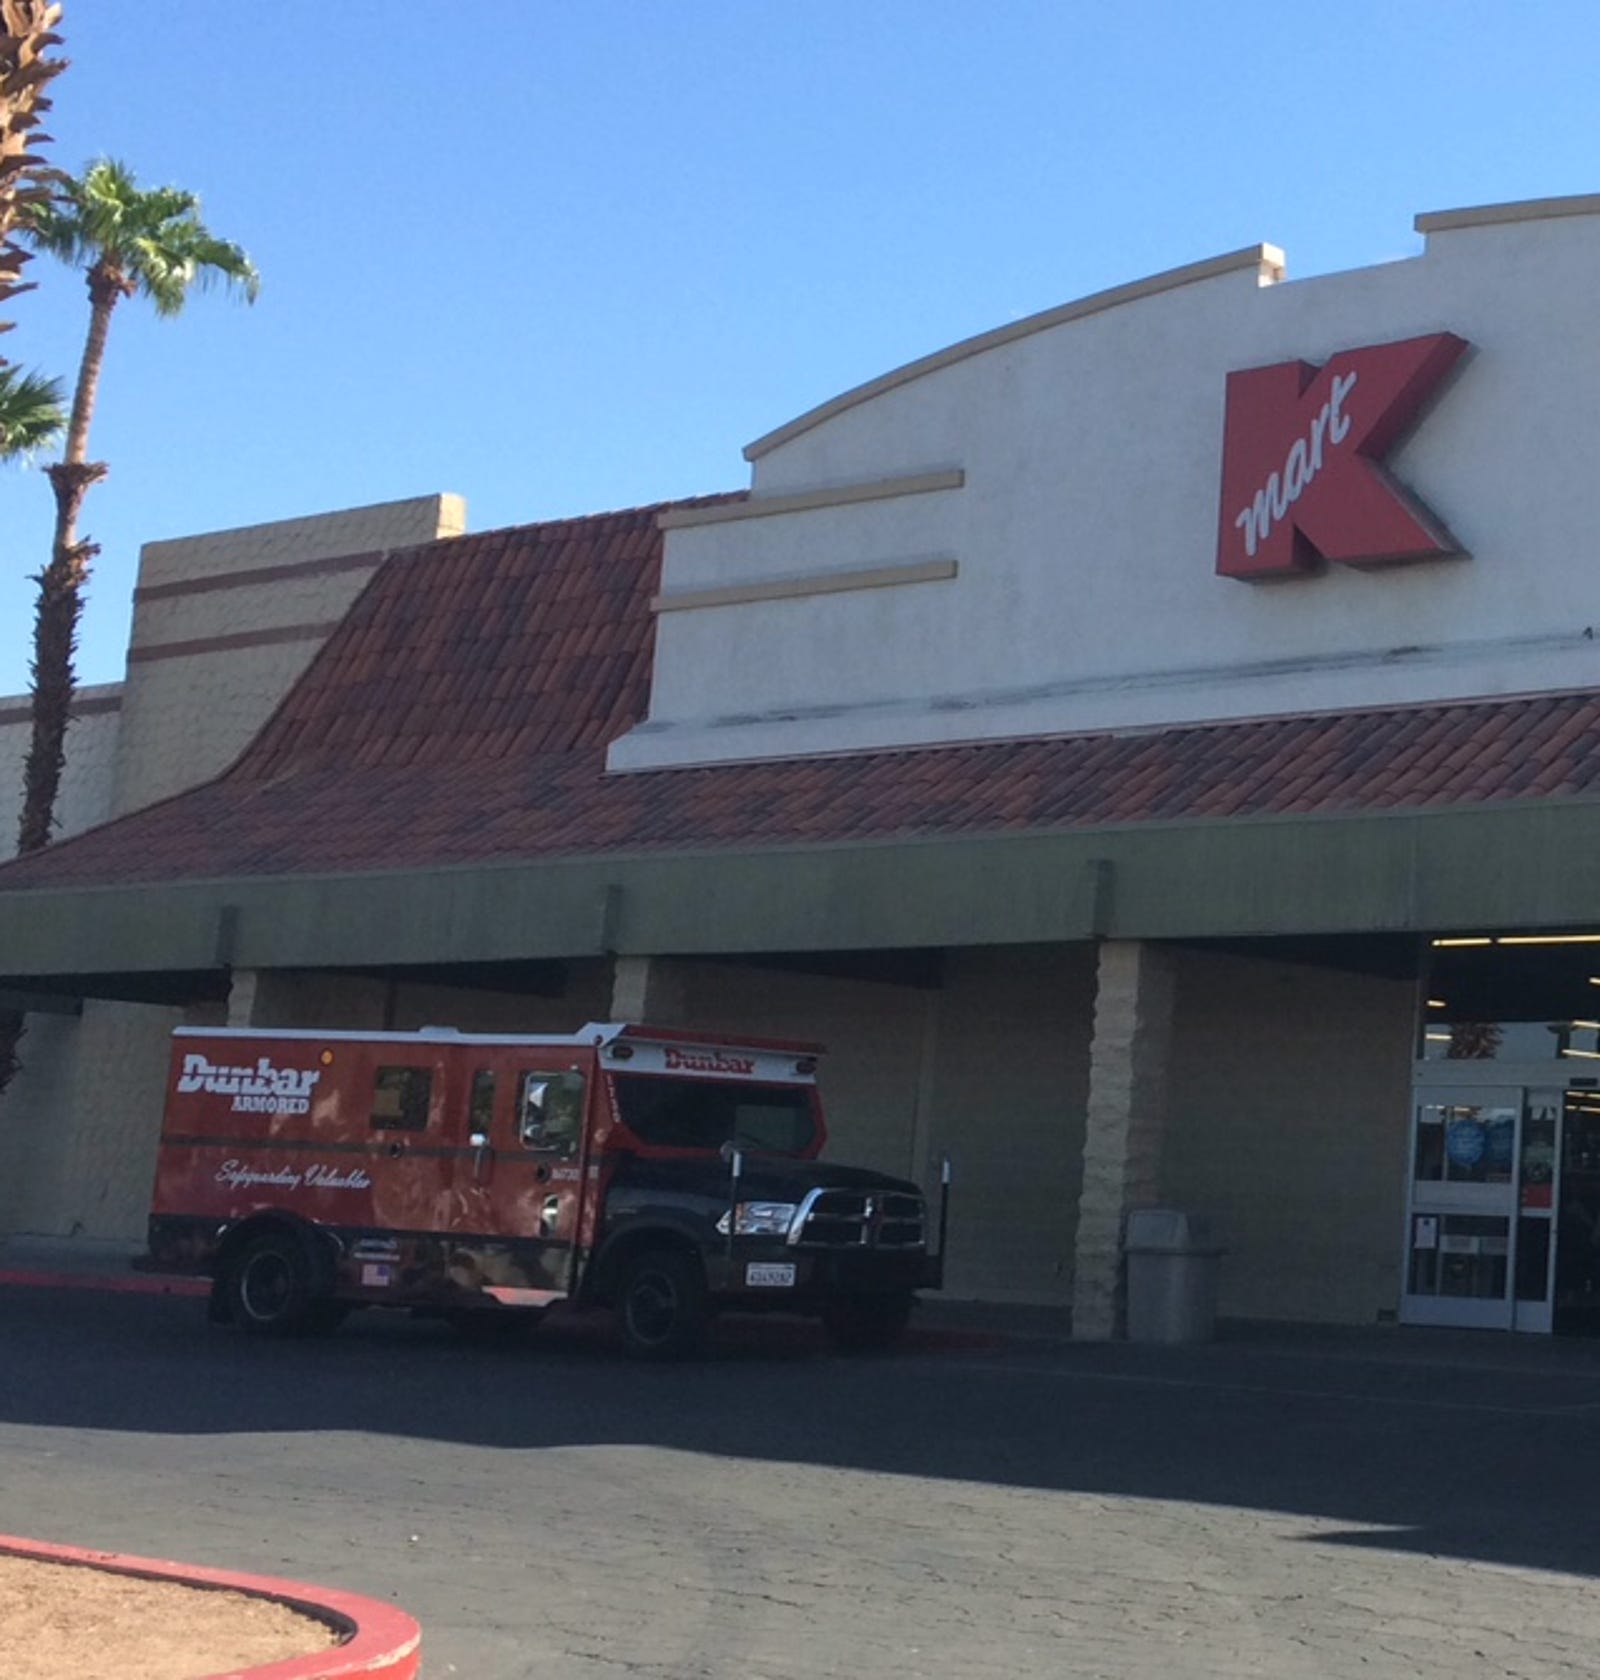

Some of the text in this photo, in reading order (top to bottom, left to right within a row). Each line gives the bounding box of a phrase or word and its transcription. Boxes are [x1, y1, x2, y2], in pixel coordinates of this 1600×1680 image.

[1216, 331, 1470, 584] K mart
[178, 1054, 320, 1097] Dunbar
[664, 1047, 756, 1074] Dunbar
[231, 1096, 310, 1114] ARMORED
[214, 1159, 302, 1190] Safeguarding
